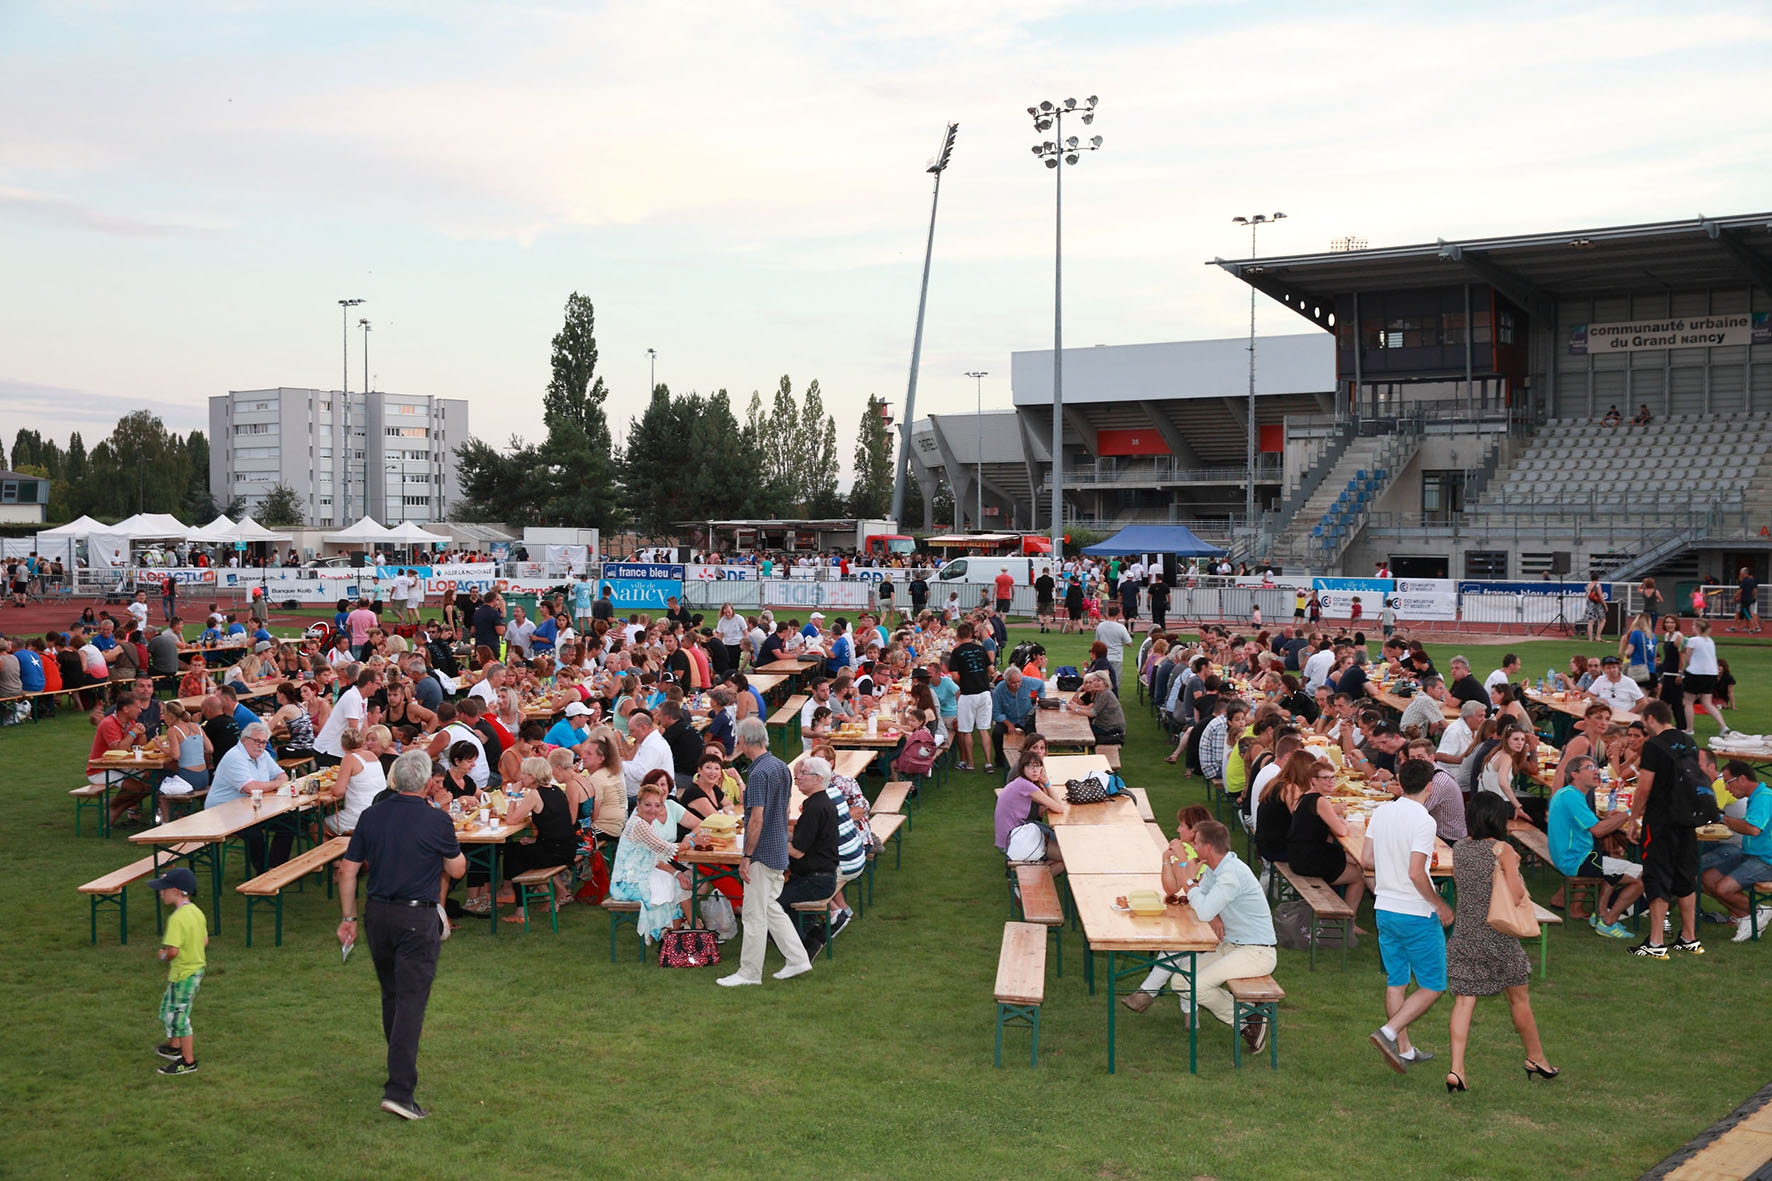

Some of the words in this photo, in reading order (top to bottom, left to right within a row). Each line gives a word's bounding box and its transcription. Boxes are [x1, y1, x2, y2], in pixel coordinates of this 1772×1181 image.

[1590, 319, 1685, 336] communauté
[1690, 316, 1748, 330] urbaine
[1610, 337, 1628, 348] du
[1632, 334, 1676, 347] Grand
[619, 566, 647, 577] france
[649, 567, 669, 578] bleu
[427, 580, 496, 592] LORACTU
[603, 581, 670, 608] Nancy
